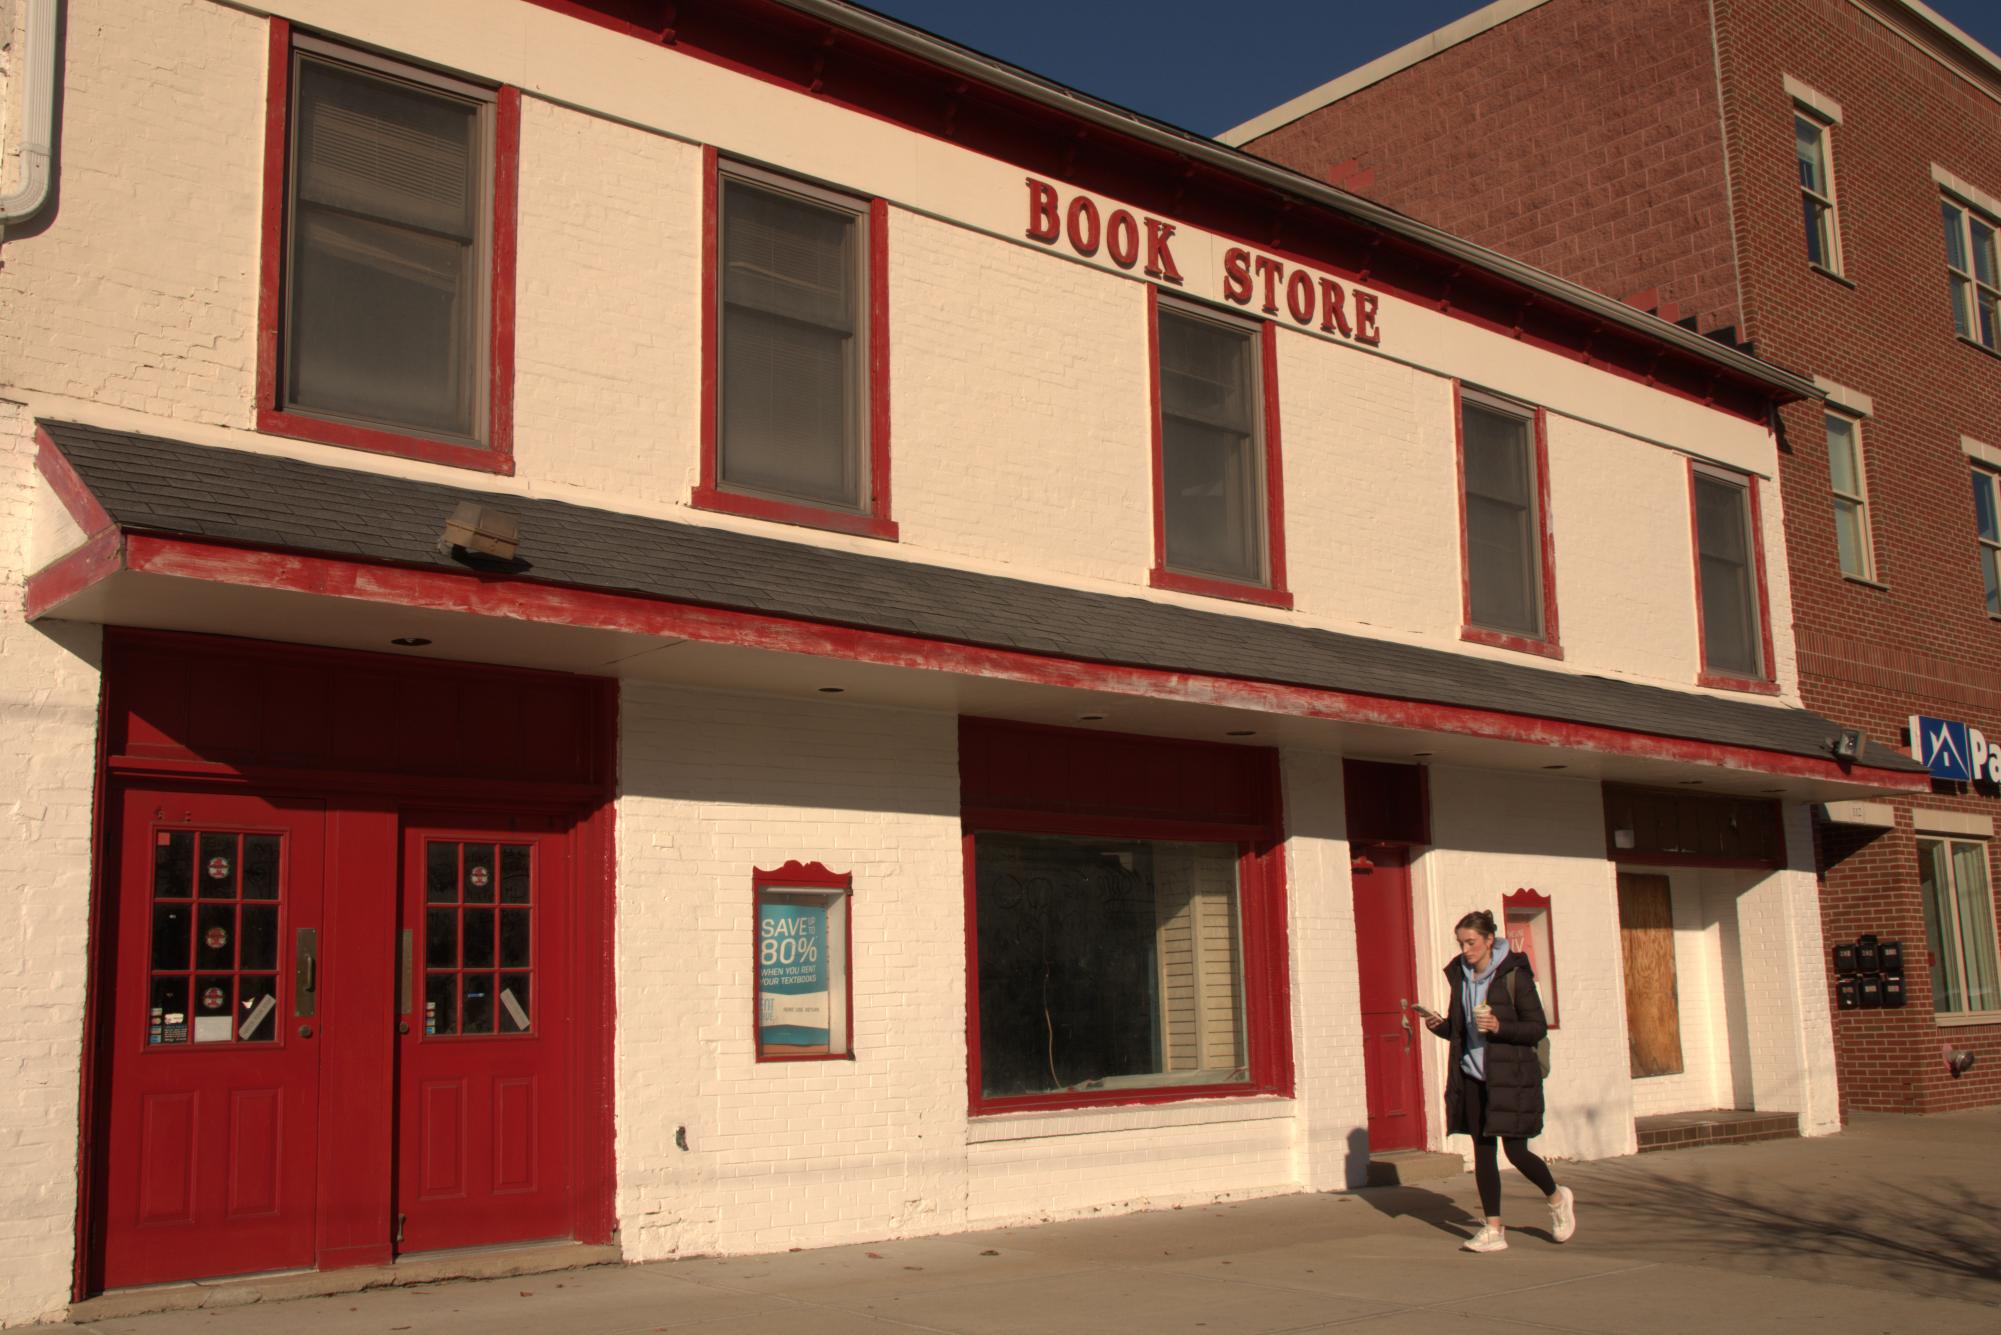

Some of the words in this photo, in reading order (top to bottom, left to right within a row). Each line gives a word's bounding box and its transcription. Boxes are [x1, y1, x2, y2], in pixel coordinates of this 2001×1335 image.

[1025, 177, 1184, 286] BOOK
[1223, 247, 1381, 348] STORE
[761, 916, 807, 938] SAVE
[761, 937, 817, 965] 80%
[760, 967, 784, 977] WHEN
[786, 966, 799, 975] YOU
[801, 965, 816, 974] RENT
[781, 974, 817, 985] TEXTBOOKS
